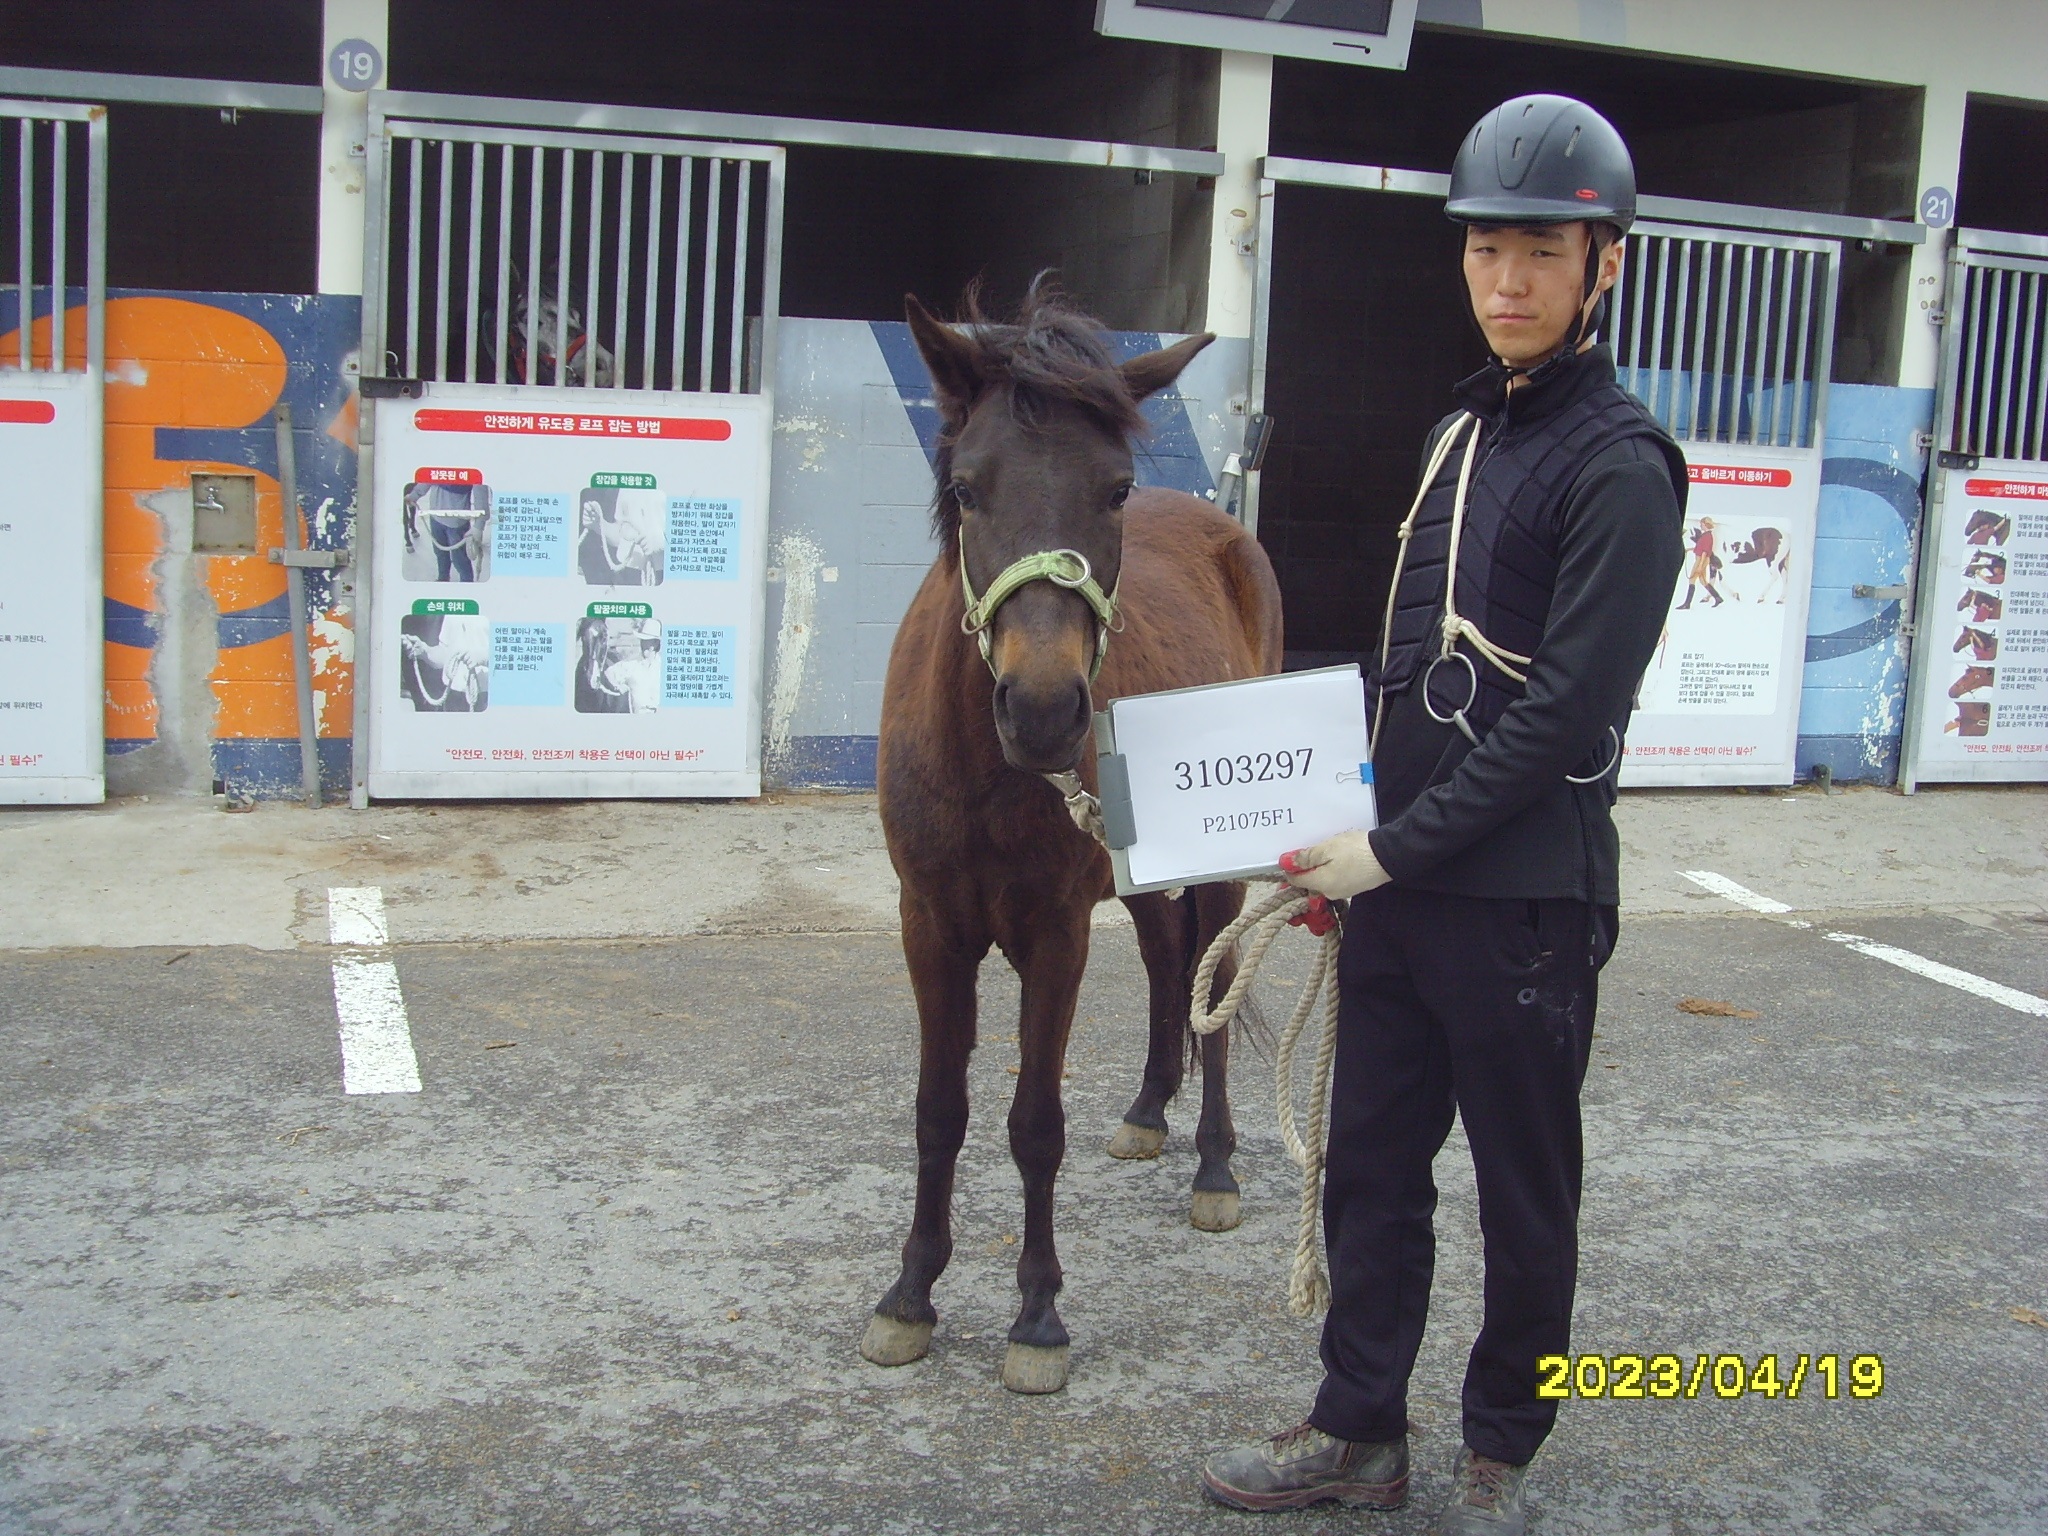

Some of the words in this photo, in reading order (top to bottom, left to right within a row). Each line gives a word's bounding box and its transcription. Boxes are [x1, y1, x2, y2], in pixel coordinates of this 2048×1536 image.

[339, 51, 373, 80] 19
[1926, 196, 1947, 219] 21
[484, 415, 533, 429] 안전하게
[538, 417, 574, 431] 유도용
[579, 419, 603, 431] 로프
[608, 419, 632, 433] 잡는
[636, 420, 660, 434] 방법
[430, 470, 456, 481] 잘못된
[459, 470, 468, 481] 예
[595, 475, 618, 485] 장갑을
[620, 475, 643, 486] 착용할
[644, 476, 652, 486] 것
[1688, 468, 1698, 478] 고
[1702, 469, 1735, 481] 올바르게
[1739, 471, 1771, 483] 이동하기
[2005, 484, 2035, 495] 안전하게
[427, 602, 445, 612] 손의
[447, 602, 465, 612] 위치
[594, 605, 627, 614] 팔꿈치의
[630, 605, 647, 615] 사용
[532, 749, 574, 760] 안전조끼
[579, 750, 610, 760] 착용은
[614, 750, 645, 760] 선택이
[649, 750, 670, 761] 아닌
[1636, 747, 1665, 756] 안전조끼
[1669, 747, 1690, 756] 착용은
[1694, 747, 1715, 756] 선택이
[1718, 747, 1732, 756] 아닌
[1174, 748, 1314, 791] 3103297
[1203, 808, 1294, 834] P21075F1
